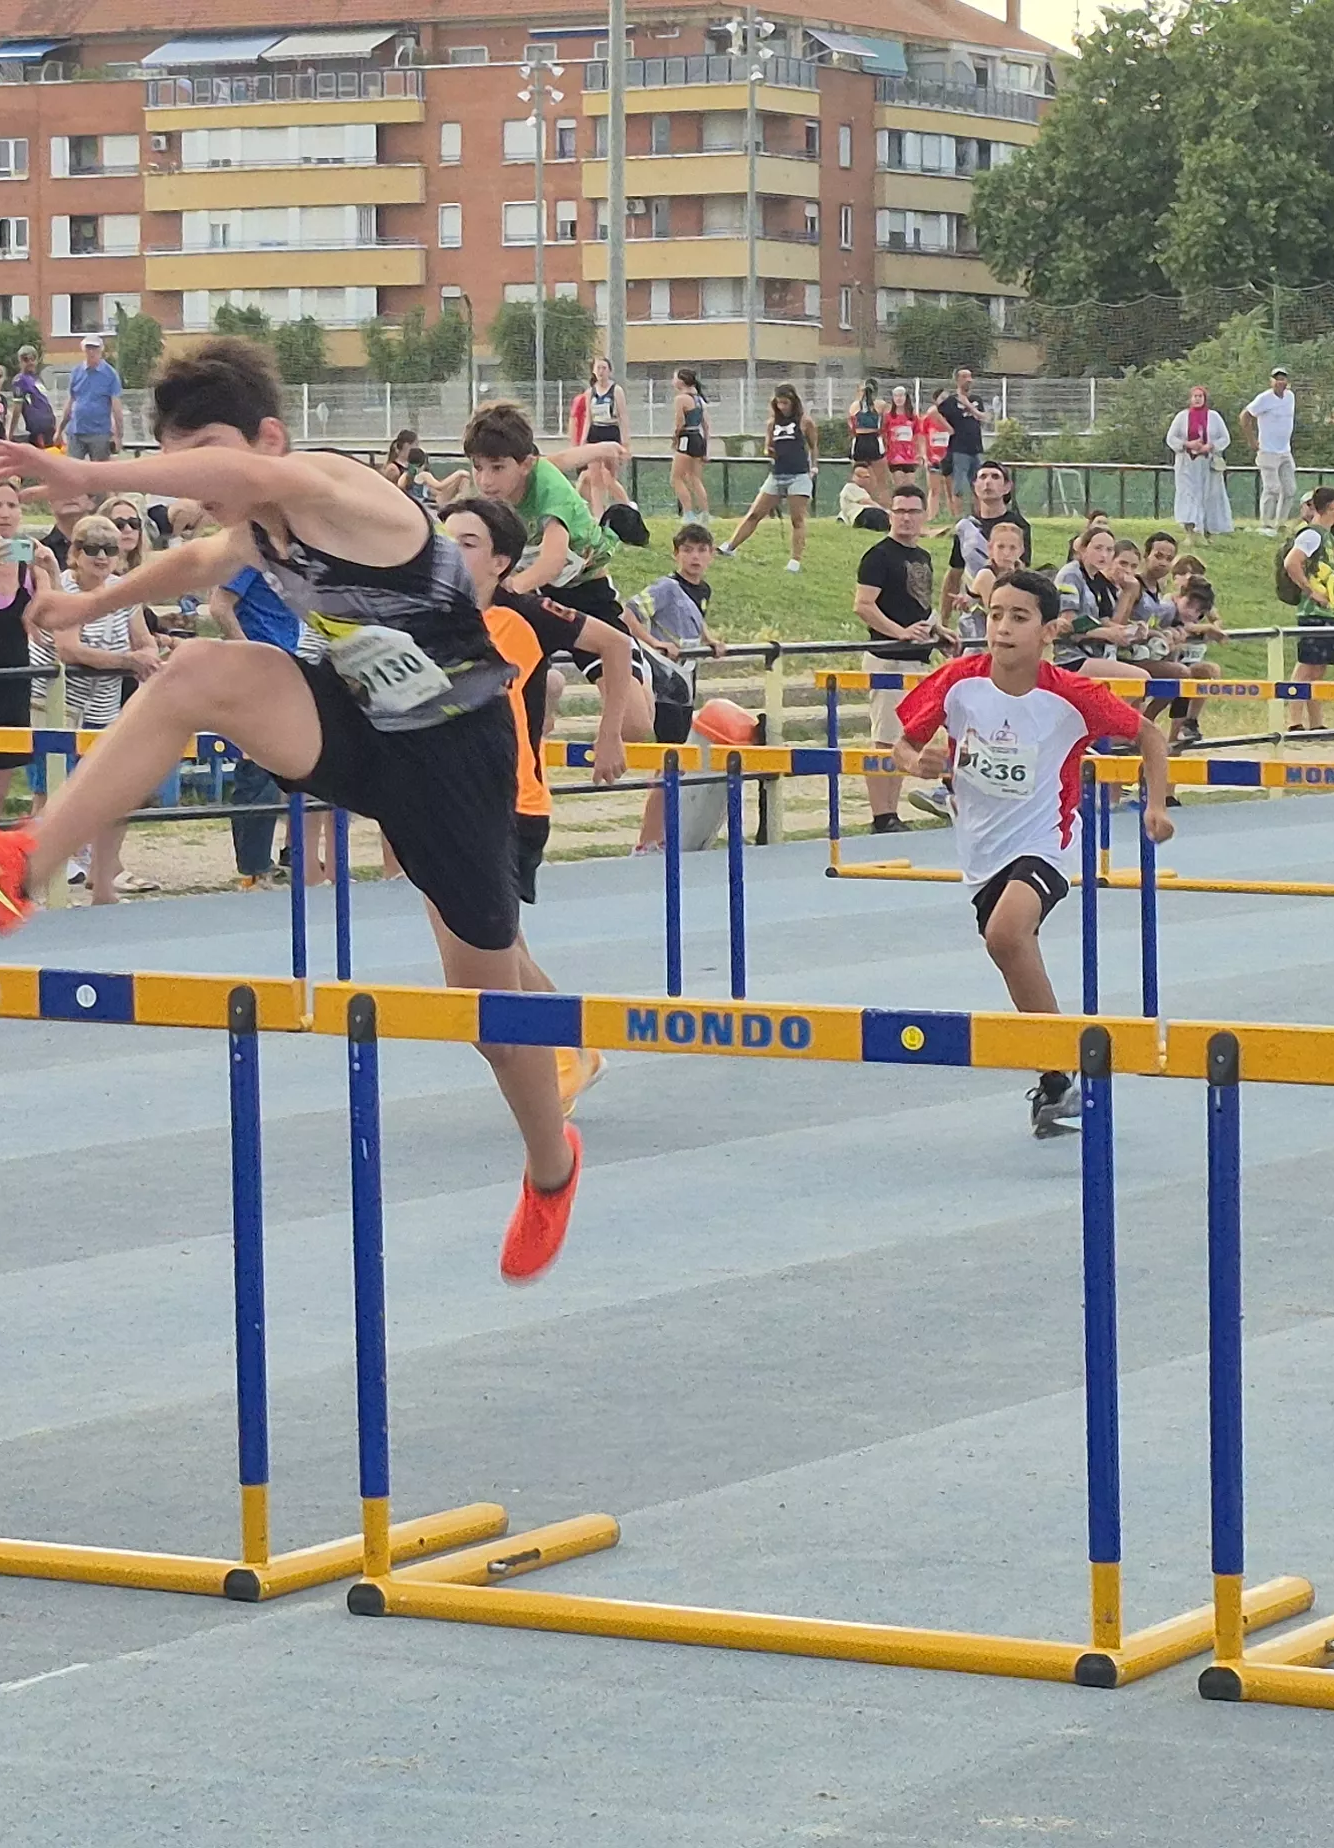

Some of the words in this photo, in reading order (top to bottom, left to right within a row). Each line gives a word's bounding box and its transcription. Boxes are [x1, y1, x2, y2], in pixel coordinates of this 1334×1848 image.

[359, 651, 425, 694] 1130
[1196, 684, 1260, 696] MONDO
[970, 752, 1027, 782] 1236
[627, 1008, 811, 1049] MONDO
